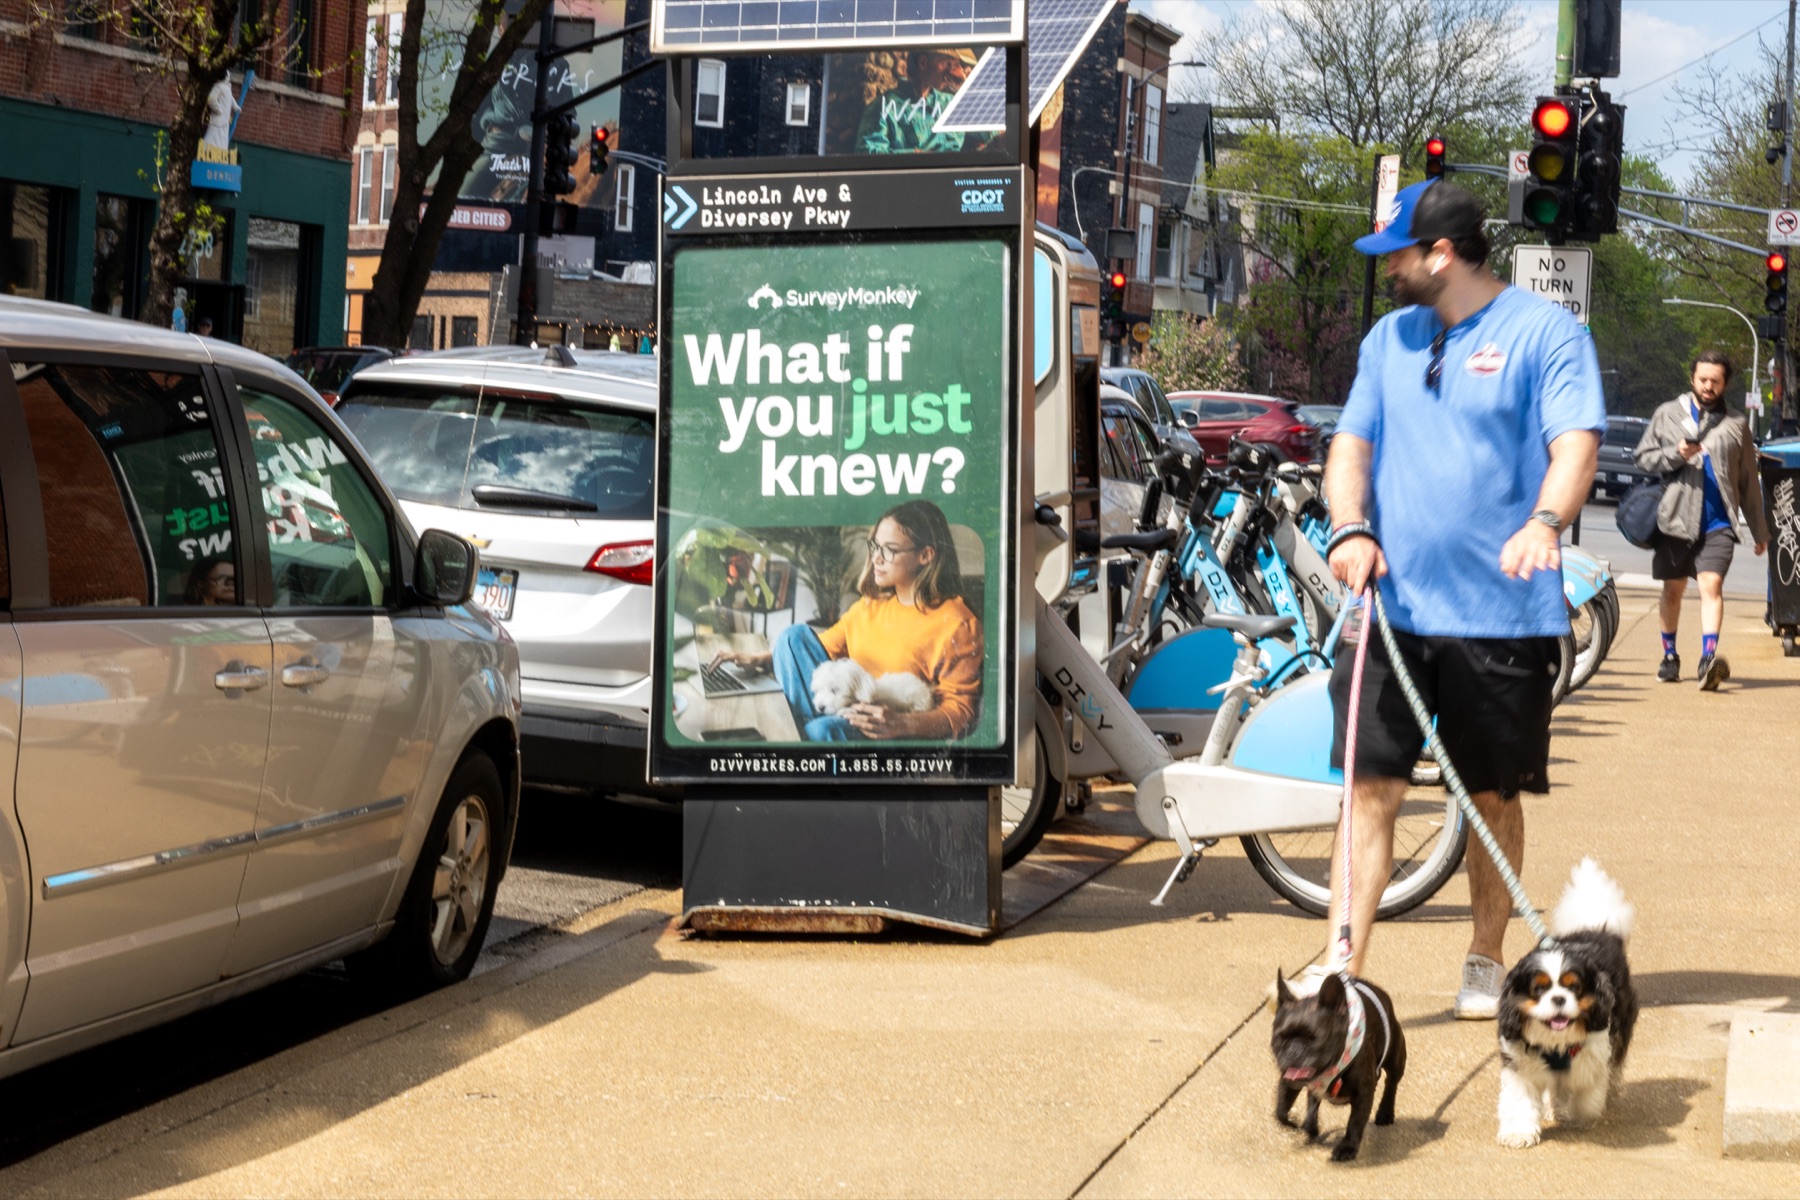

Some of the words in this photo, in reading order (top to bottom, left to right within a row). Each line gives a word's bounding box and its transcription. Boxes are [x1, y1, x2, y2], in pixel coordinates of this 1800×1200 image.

[702, 185, 782, 206] Lincoln
[792, 184, 828, 204] Ave
[838, 183, 852, 203] &
[961, 189, 1005, 205] CDOT
[472, 210, 506, 227] CITIES
[701, 208, 794, 230] Diversey
[804, 206, 851, 229] Pkwy
[1539, 257, 1567, 273] NO
[1529, 278, 1574, 294] TURN
[786, 286, 918, 312] SurveyMonkey
[682, 328, 852, 387] What
[867, 323, 915, 382] if
[718, 394, 834, 453] you
[844, 377, 973, 451] just
[760, 439, 966, 497] knew?
[710, 758, 826, 772] DIVVYBIKES.COM
[839, 758, 954, 772] 1.855.55.DIVVY
